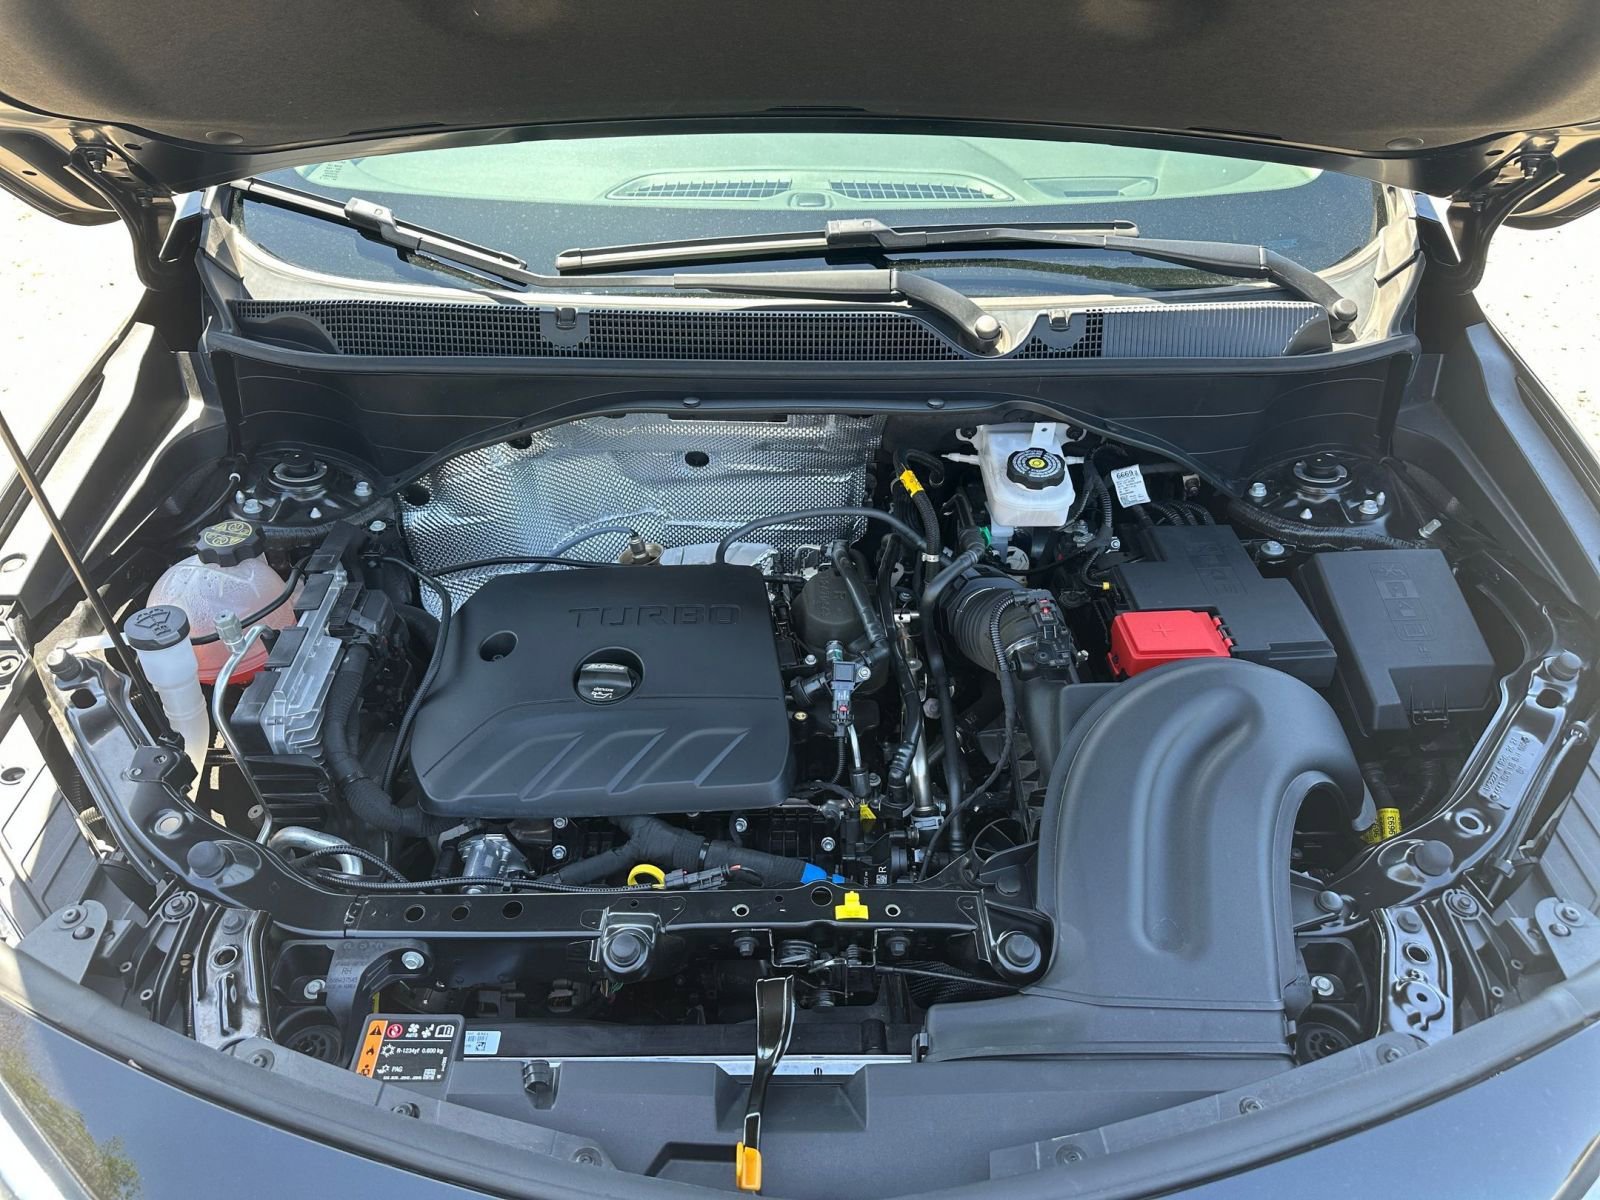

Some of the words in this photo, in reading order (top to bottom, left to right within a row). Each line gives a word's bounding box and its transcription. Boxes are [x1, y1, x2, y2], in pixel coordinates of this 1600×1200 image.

[568, 603, 742, 628] TURBO
[1387, 815, 1395, 835] 9693
[436, 1047, 444, 1055] kg
